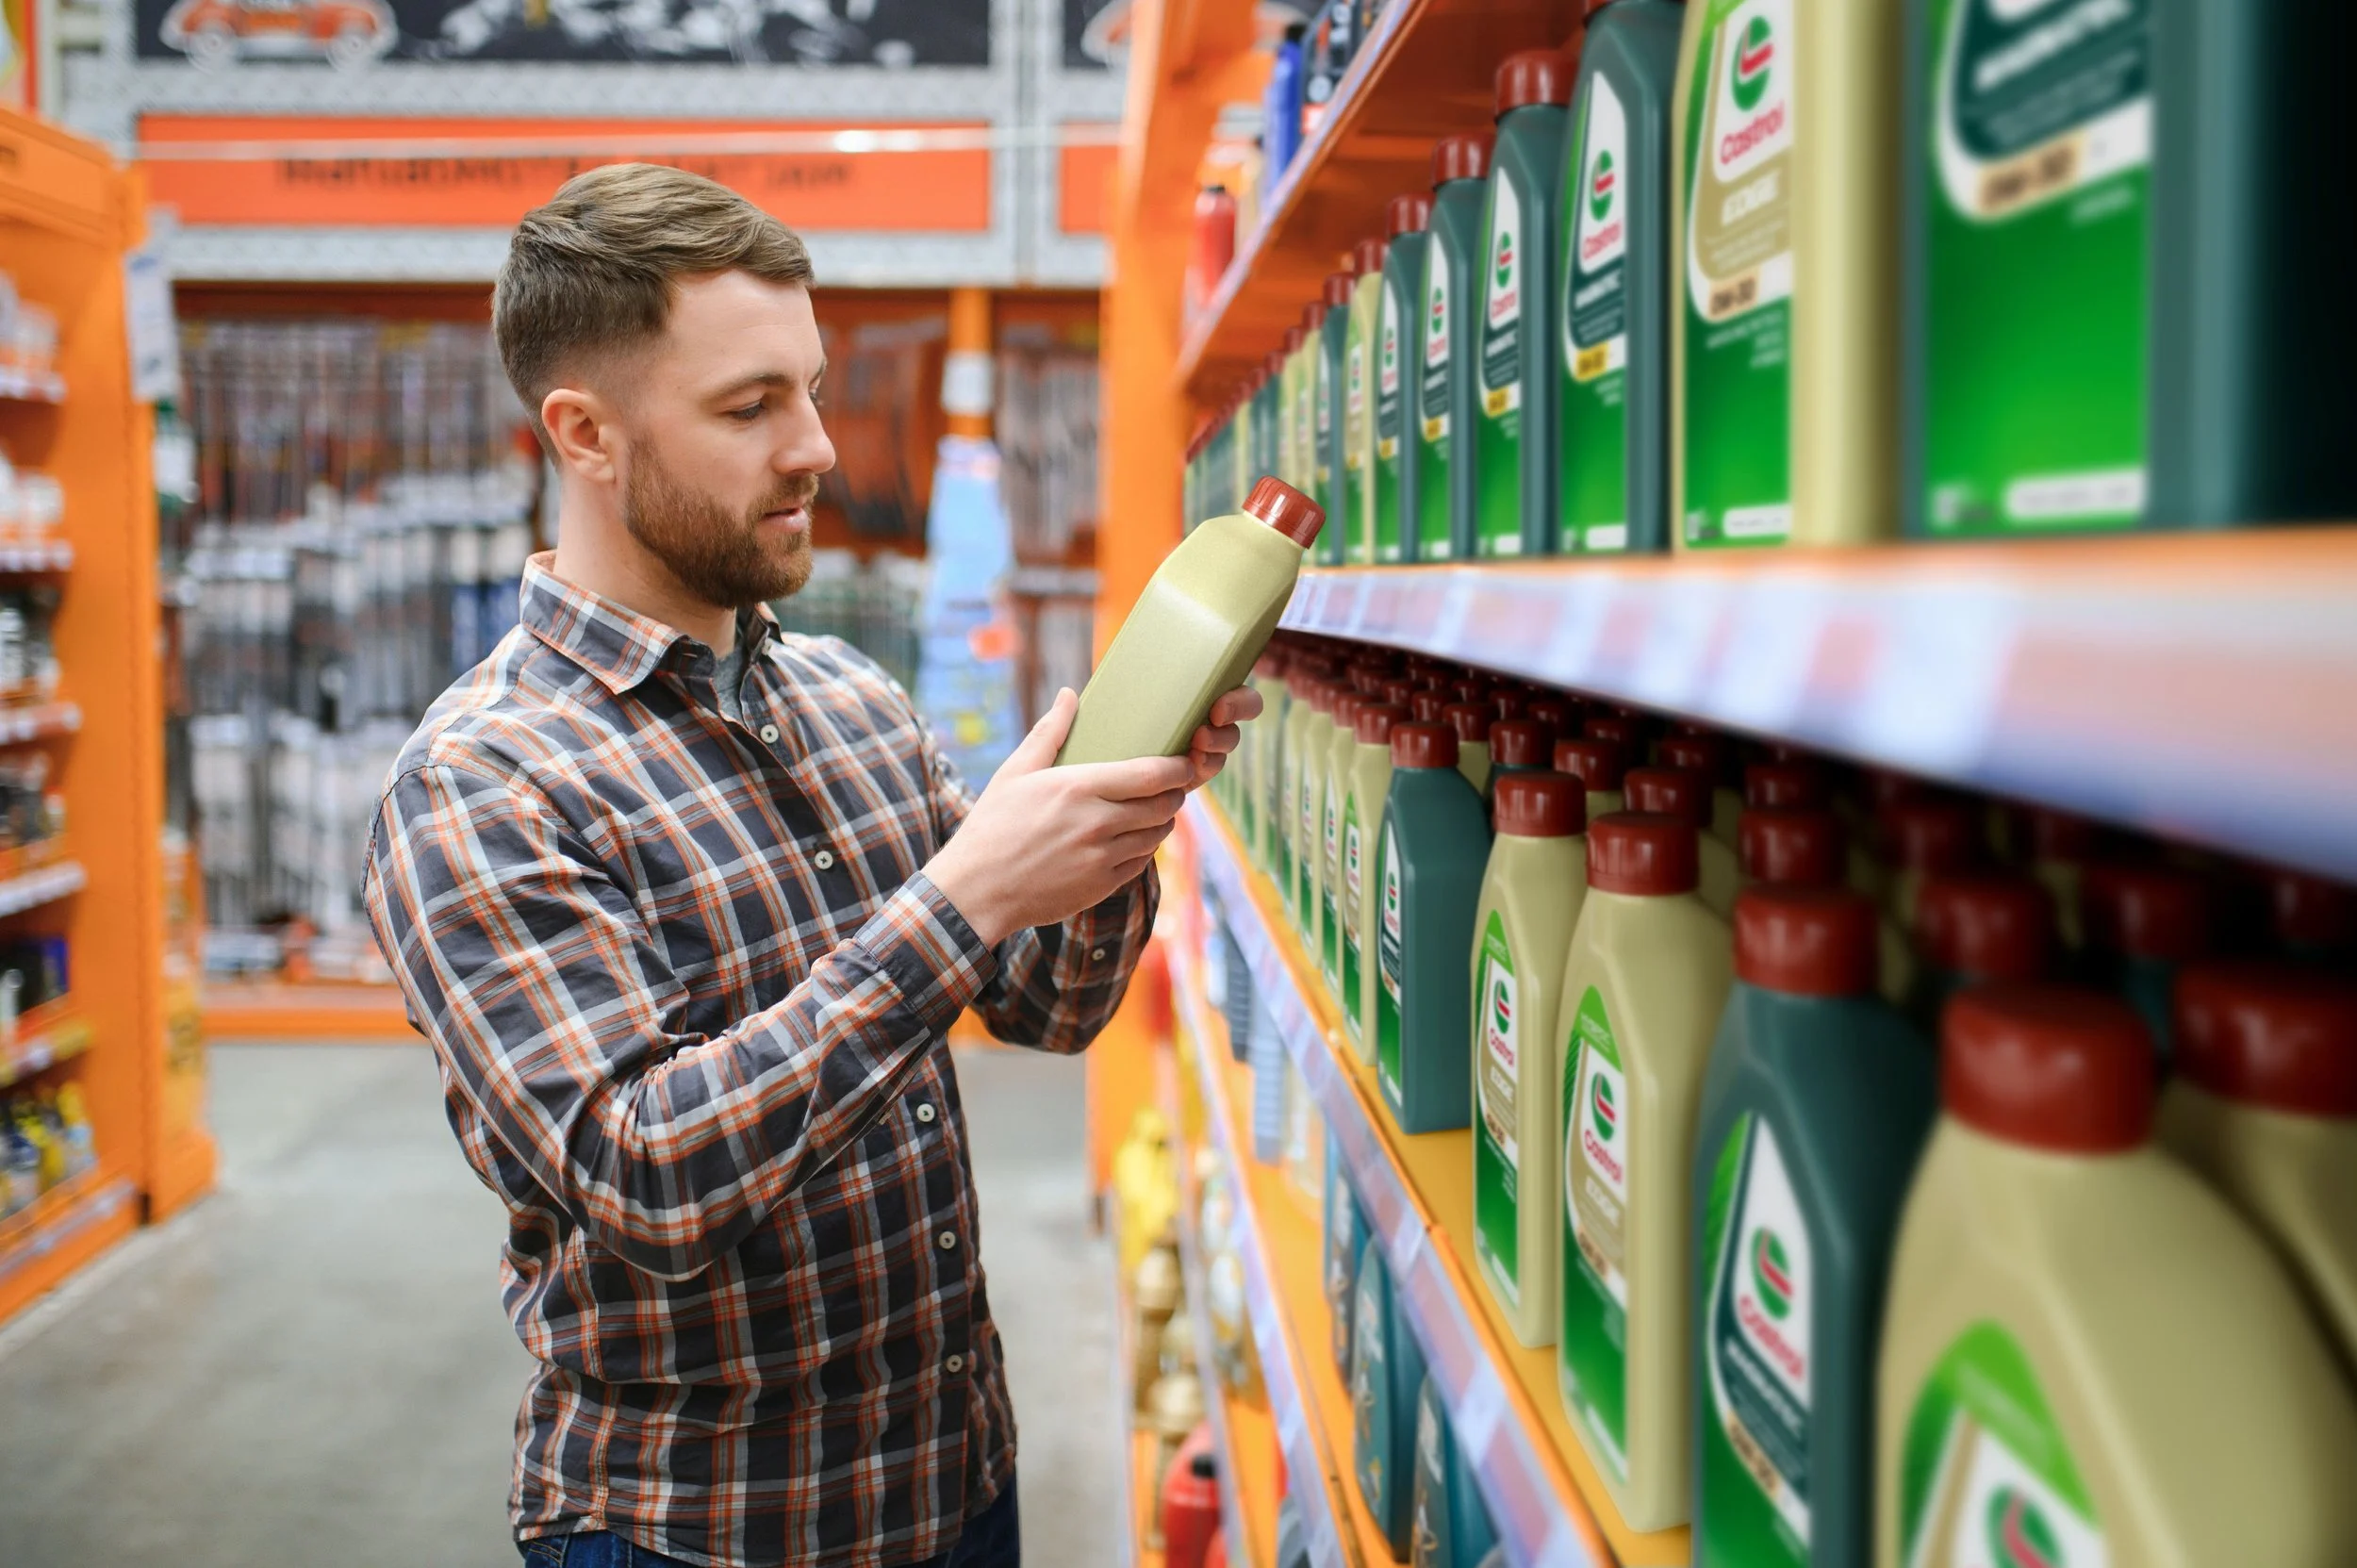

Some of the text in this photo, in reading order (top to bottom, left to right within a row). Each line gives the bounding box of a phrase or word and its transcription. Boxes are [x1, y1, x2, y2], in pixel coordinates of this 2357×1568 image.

[1720, 98, 1785, 165] Castrol
[1490, 1028, 1515, 1068] Castrol
[1584, 1130, 1623, 1185] Castrol
